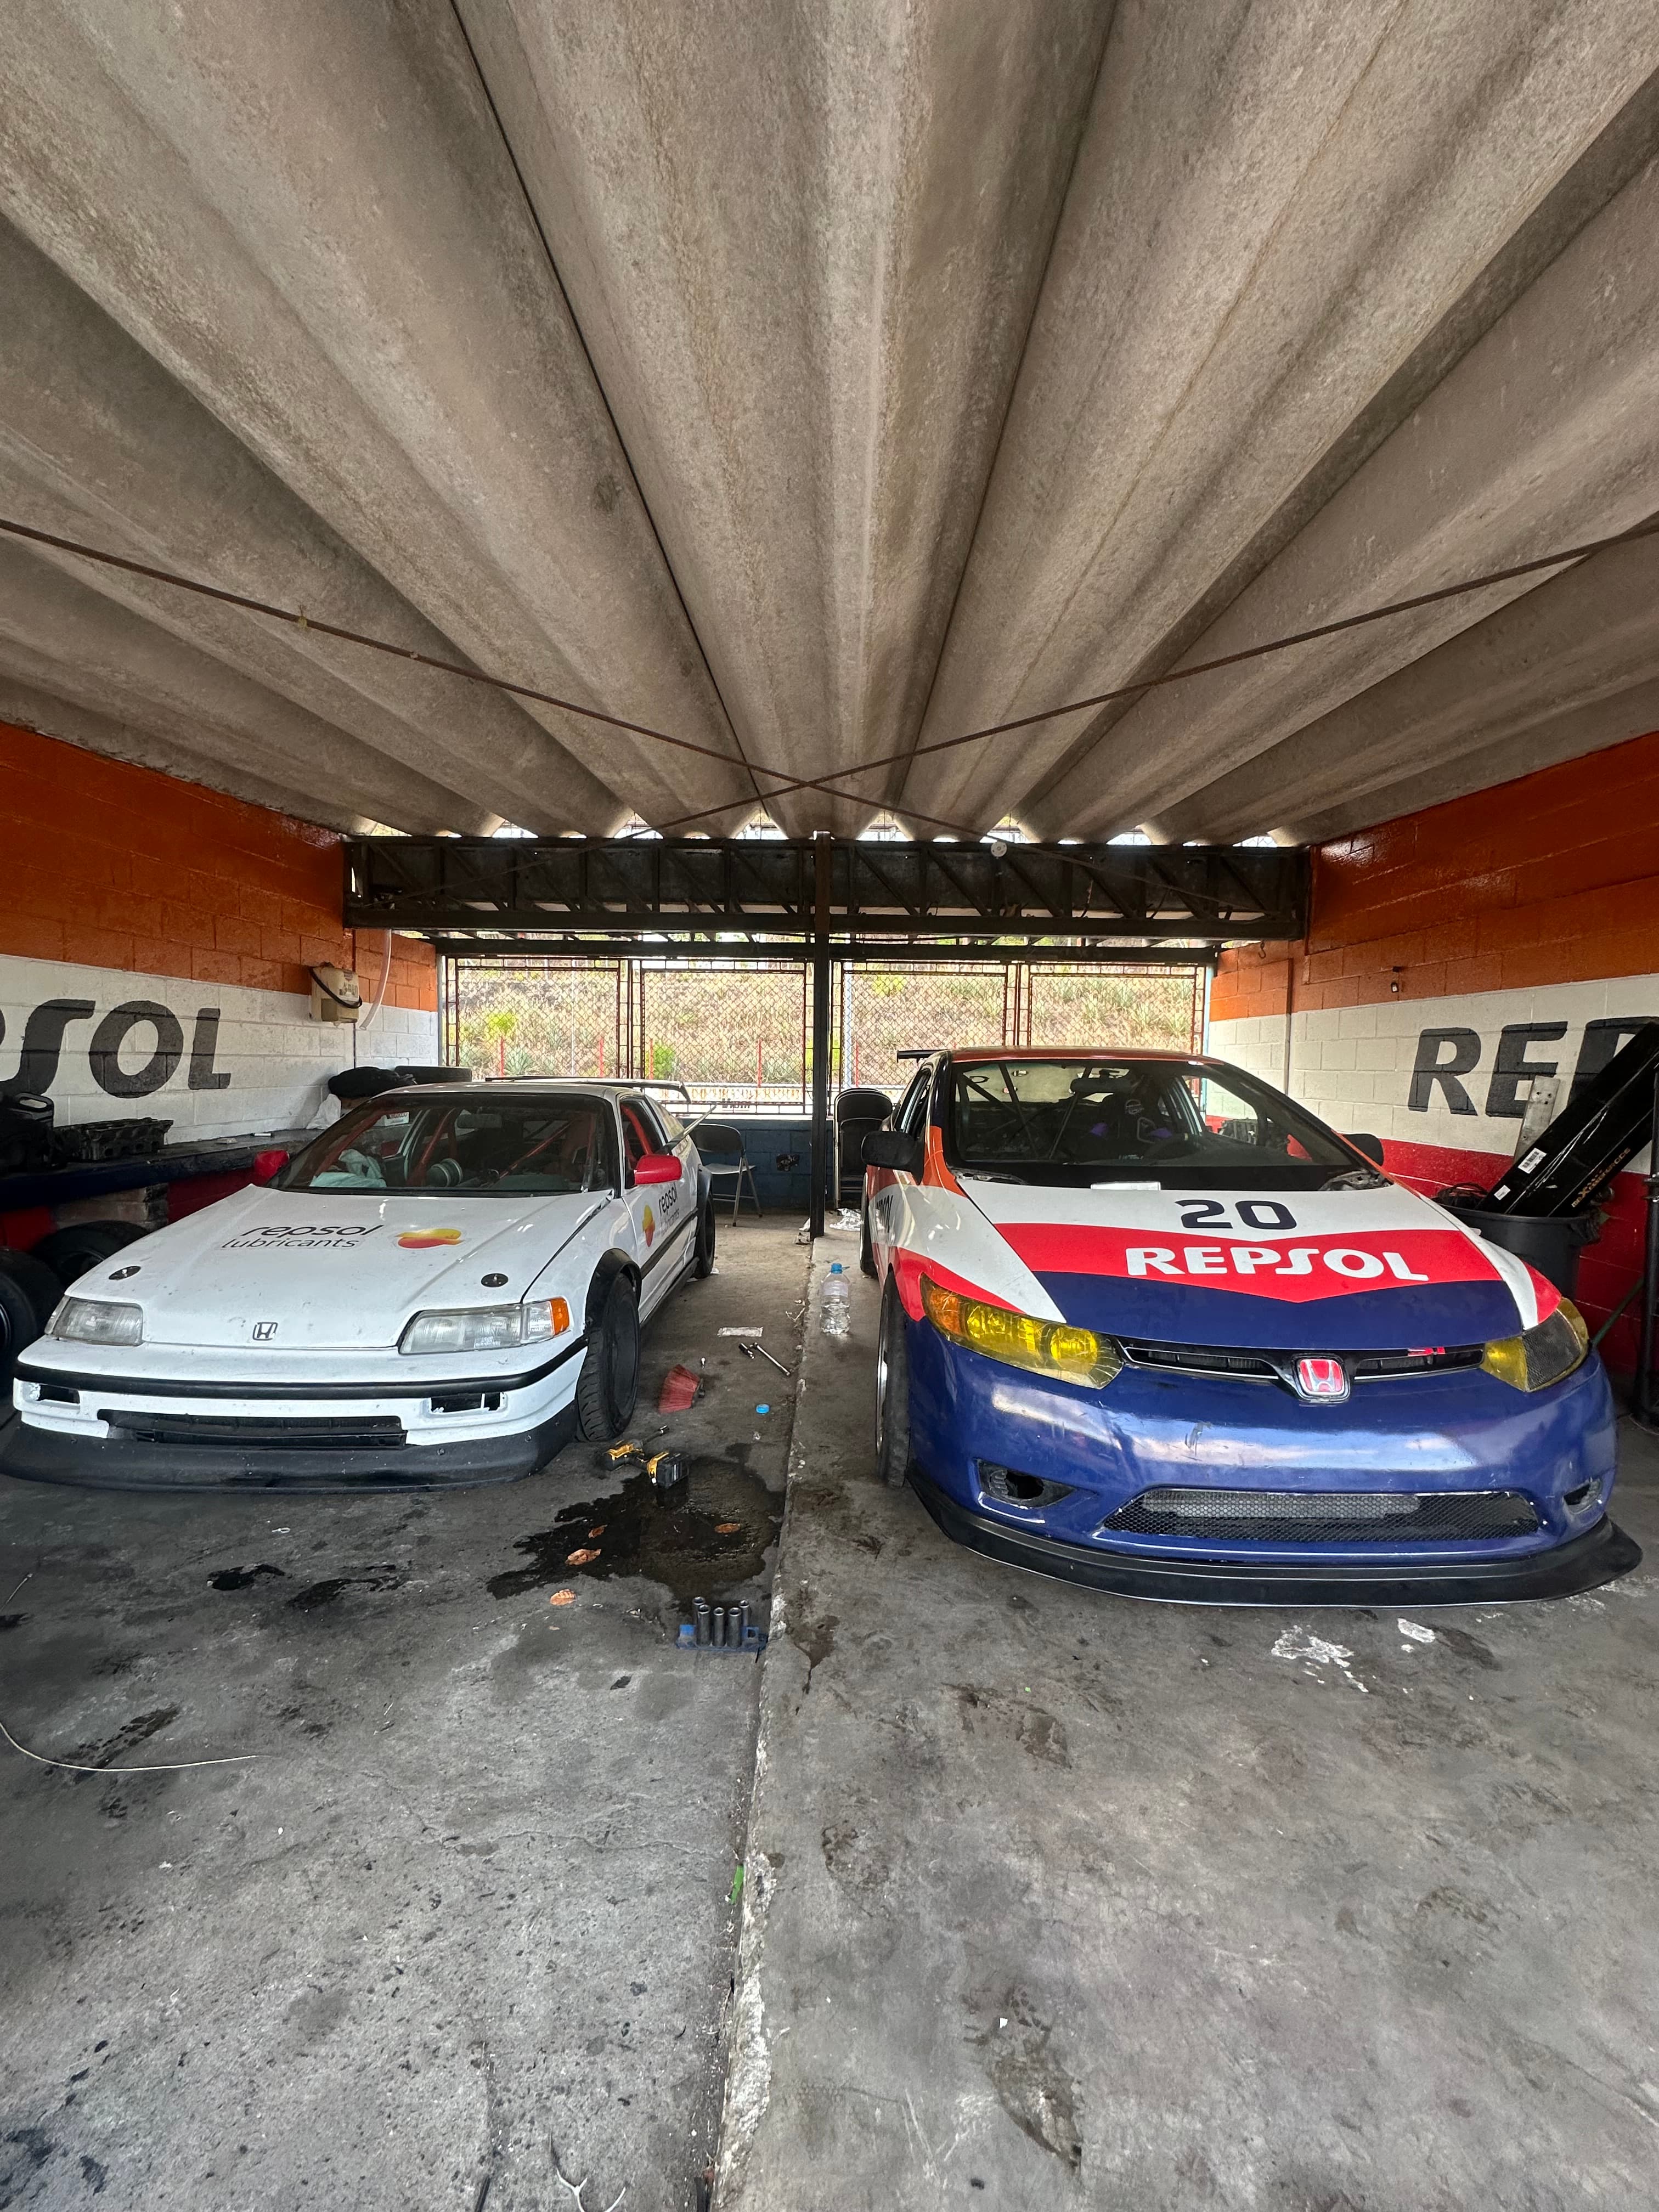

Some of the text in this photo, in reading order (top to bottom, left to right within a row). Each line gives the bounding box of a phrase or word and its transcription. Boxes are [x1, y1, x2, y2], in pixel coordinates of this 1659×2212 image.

[0, 998, 232, 1099] SOL
[658, 1182, 678, 1216] repsol
[1175, 1199, 1297, 1230] 20
[221, 1238, 359, 1248] lubricants
[240, 1224, 385, 1238] repsol
[1125, 1246, 1430, 1282] REPSOL
